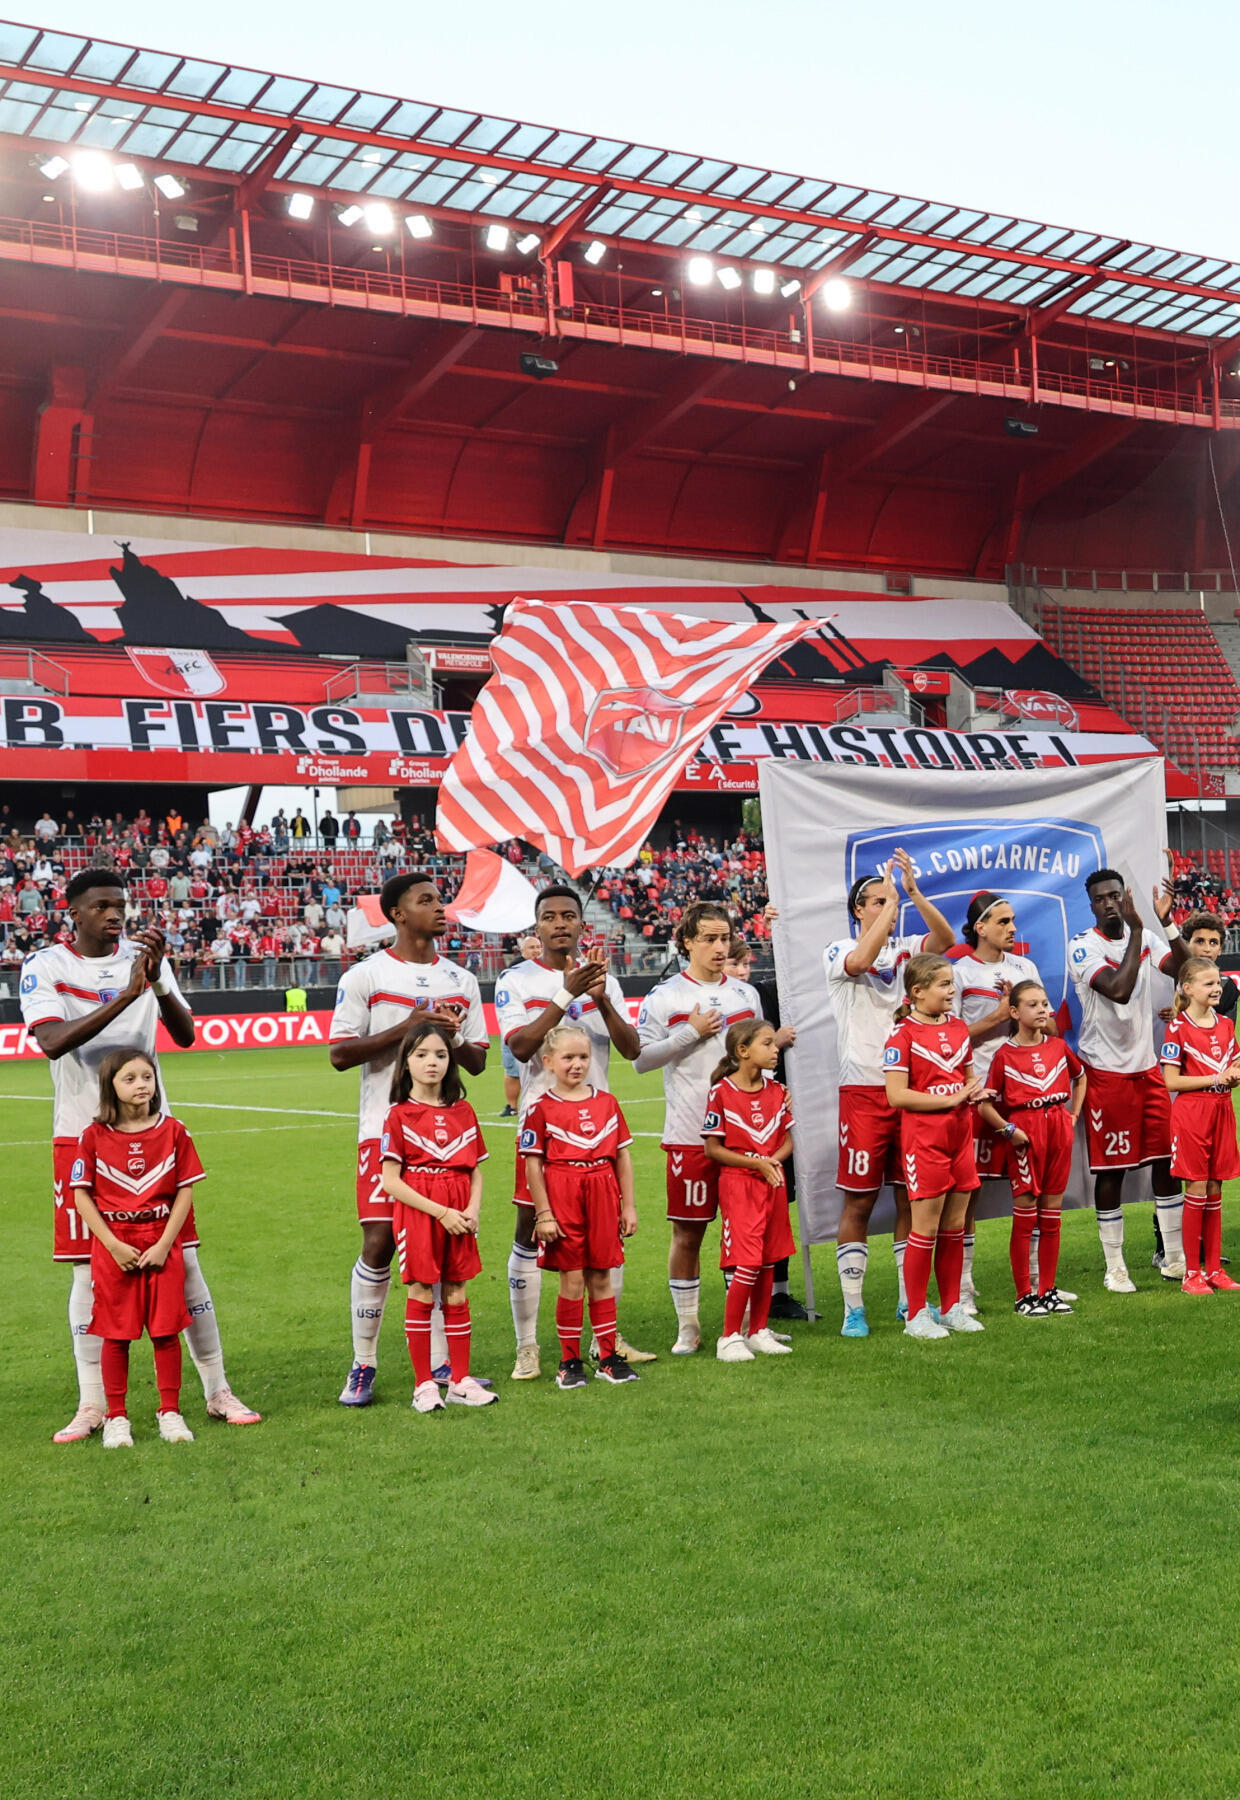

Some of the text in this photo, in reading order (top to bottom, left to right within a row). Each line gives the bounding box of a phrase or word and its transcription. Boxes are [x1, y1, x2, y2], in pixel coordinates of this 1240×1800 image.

[124, 701, 372, 757] FIERS
[760, 722, 1040, 770] HISTOIRE
[309, 766, 368, 778] Dhollande
[401, 768, 448, 779] Dhollan
[1104, 1131, 1131, 1156] 25
[848, 1148, 870, 1177] 18
[368, 1174, 396, 1204] 2
[684, 1179, 706, 1207] 10
[103, 1203, 170, 1222] TOYOTA
[509, 1277, 527, 1290] SC
[357, 1308, 382, 1319] USC
[73, 1324, 88, 1336] US
